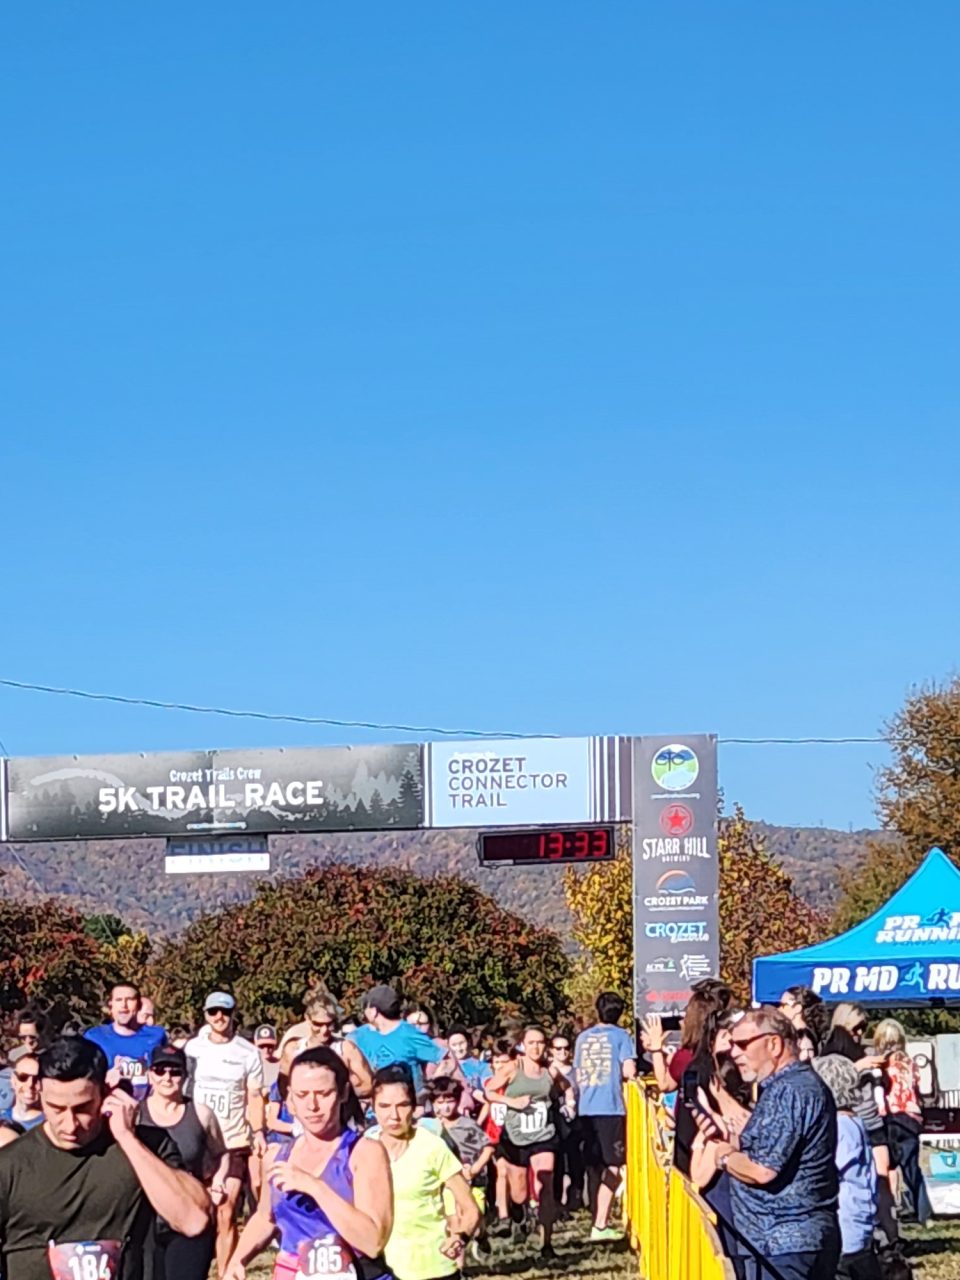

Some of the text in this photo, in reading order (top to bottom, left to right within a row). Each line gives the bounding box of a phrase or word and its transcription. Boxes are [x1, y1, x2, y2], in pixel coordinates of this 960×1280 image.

[448, 757, 526, 774] CROZET
[169, 766, 262, 783] Crozet Trails Crew
[448, 773, 567, 791] CONNECTOR
[98, 780, 324, 813] 5K TRAIL RACE
[448, 793, 508, 809] TRAIL
[643, 836, 711, 860] STARR HILL
[645, 922, 706, 937] CROZET
[883, 915, 920, 930] PR
[876, 927, 960, 943] RUNNI
[812, 963, 960, 994] PR MD RU
[307, 1245, 342, 1274] 185
